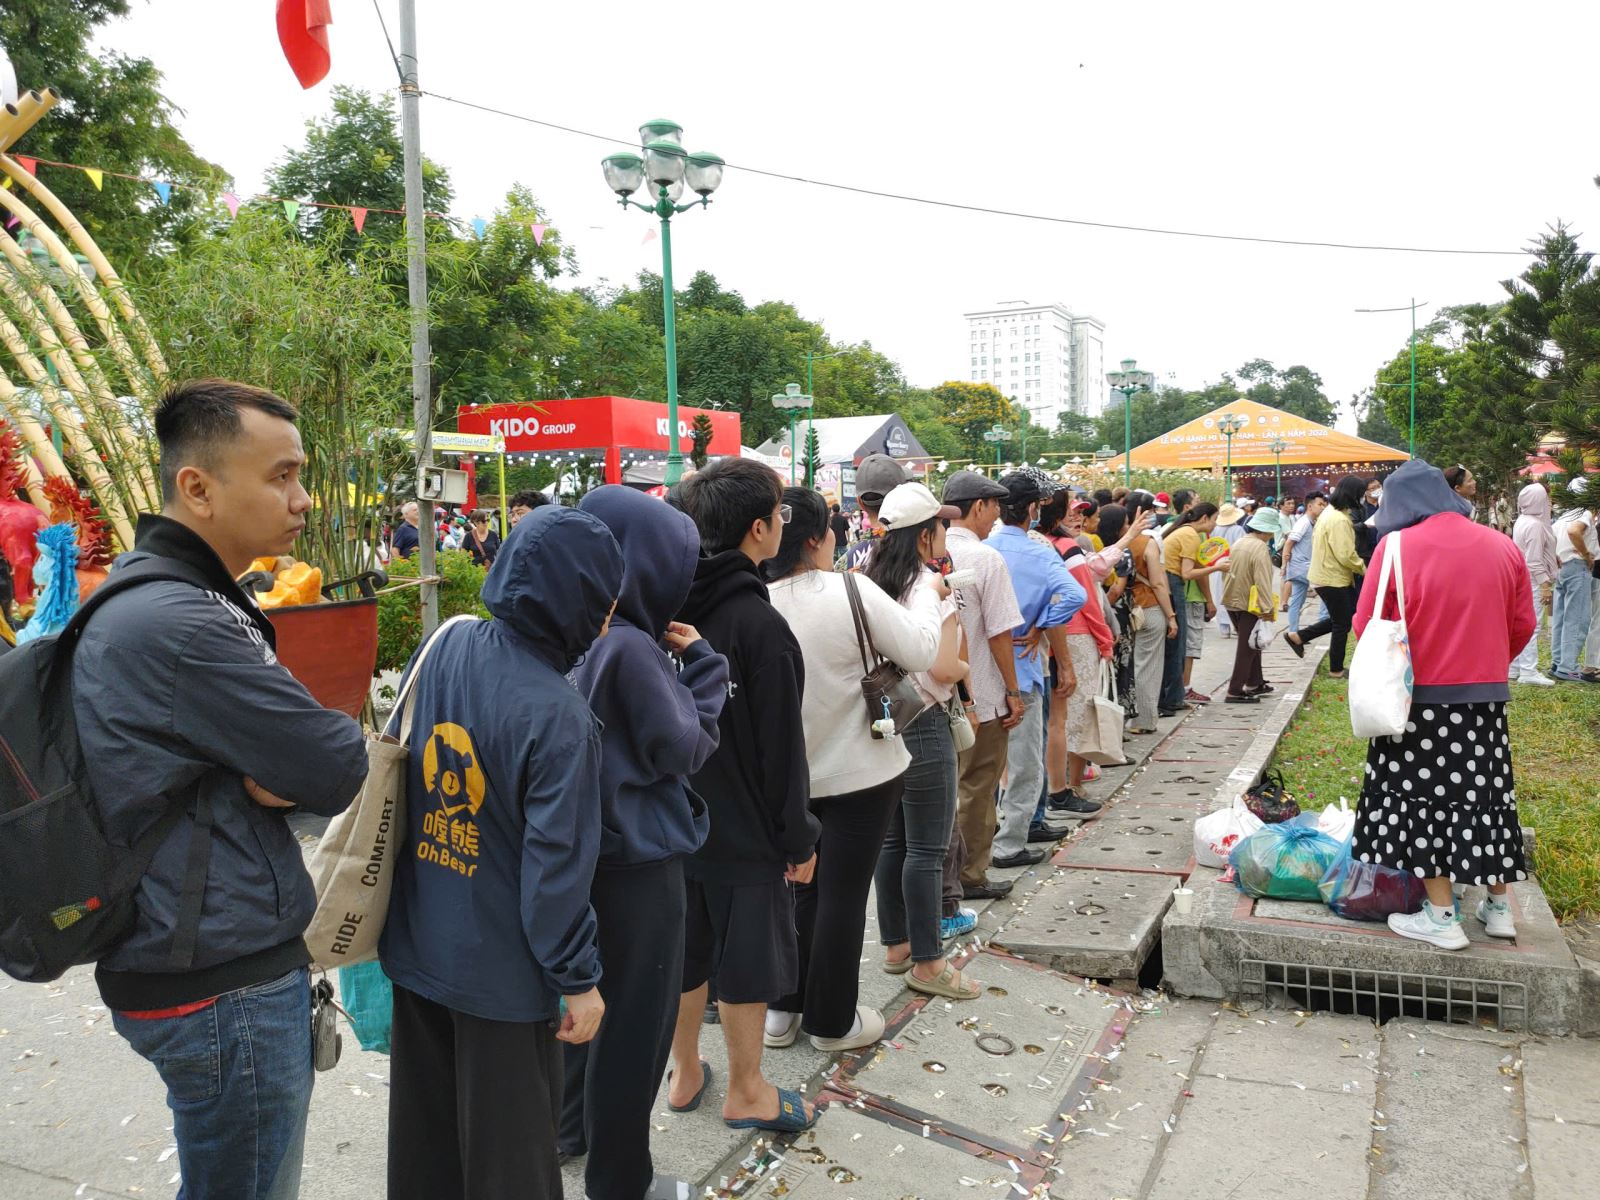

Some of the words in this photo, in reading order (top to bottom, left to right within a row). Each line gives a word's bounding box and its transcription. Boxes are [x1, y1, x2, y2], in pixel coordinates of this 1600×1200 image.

[489, 417, 539, 437] KIDO
[542, 423, 576, 435] GROUP
[656, 418, 686, 436] KIO
[423, 809, 480, 857] 喔熊
[330, 911, 363, 955] RIDE
[360, 797, 394, 887] COMFORT
[417, 841, 478, 878] OhBear
